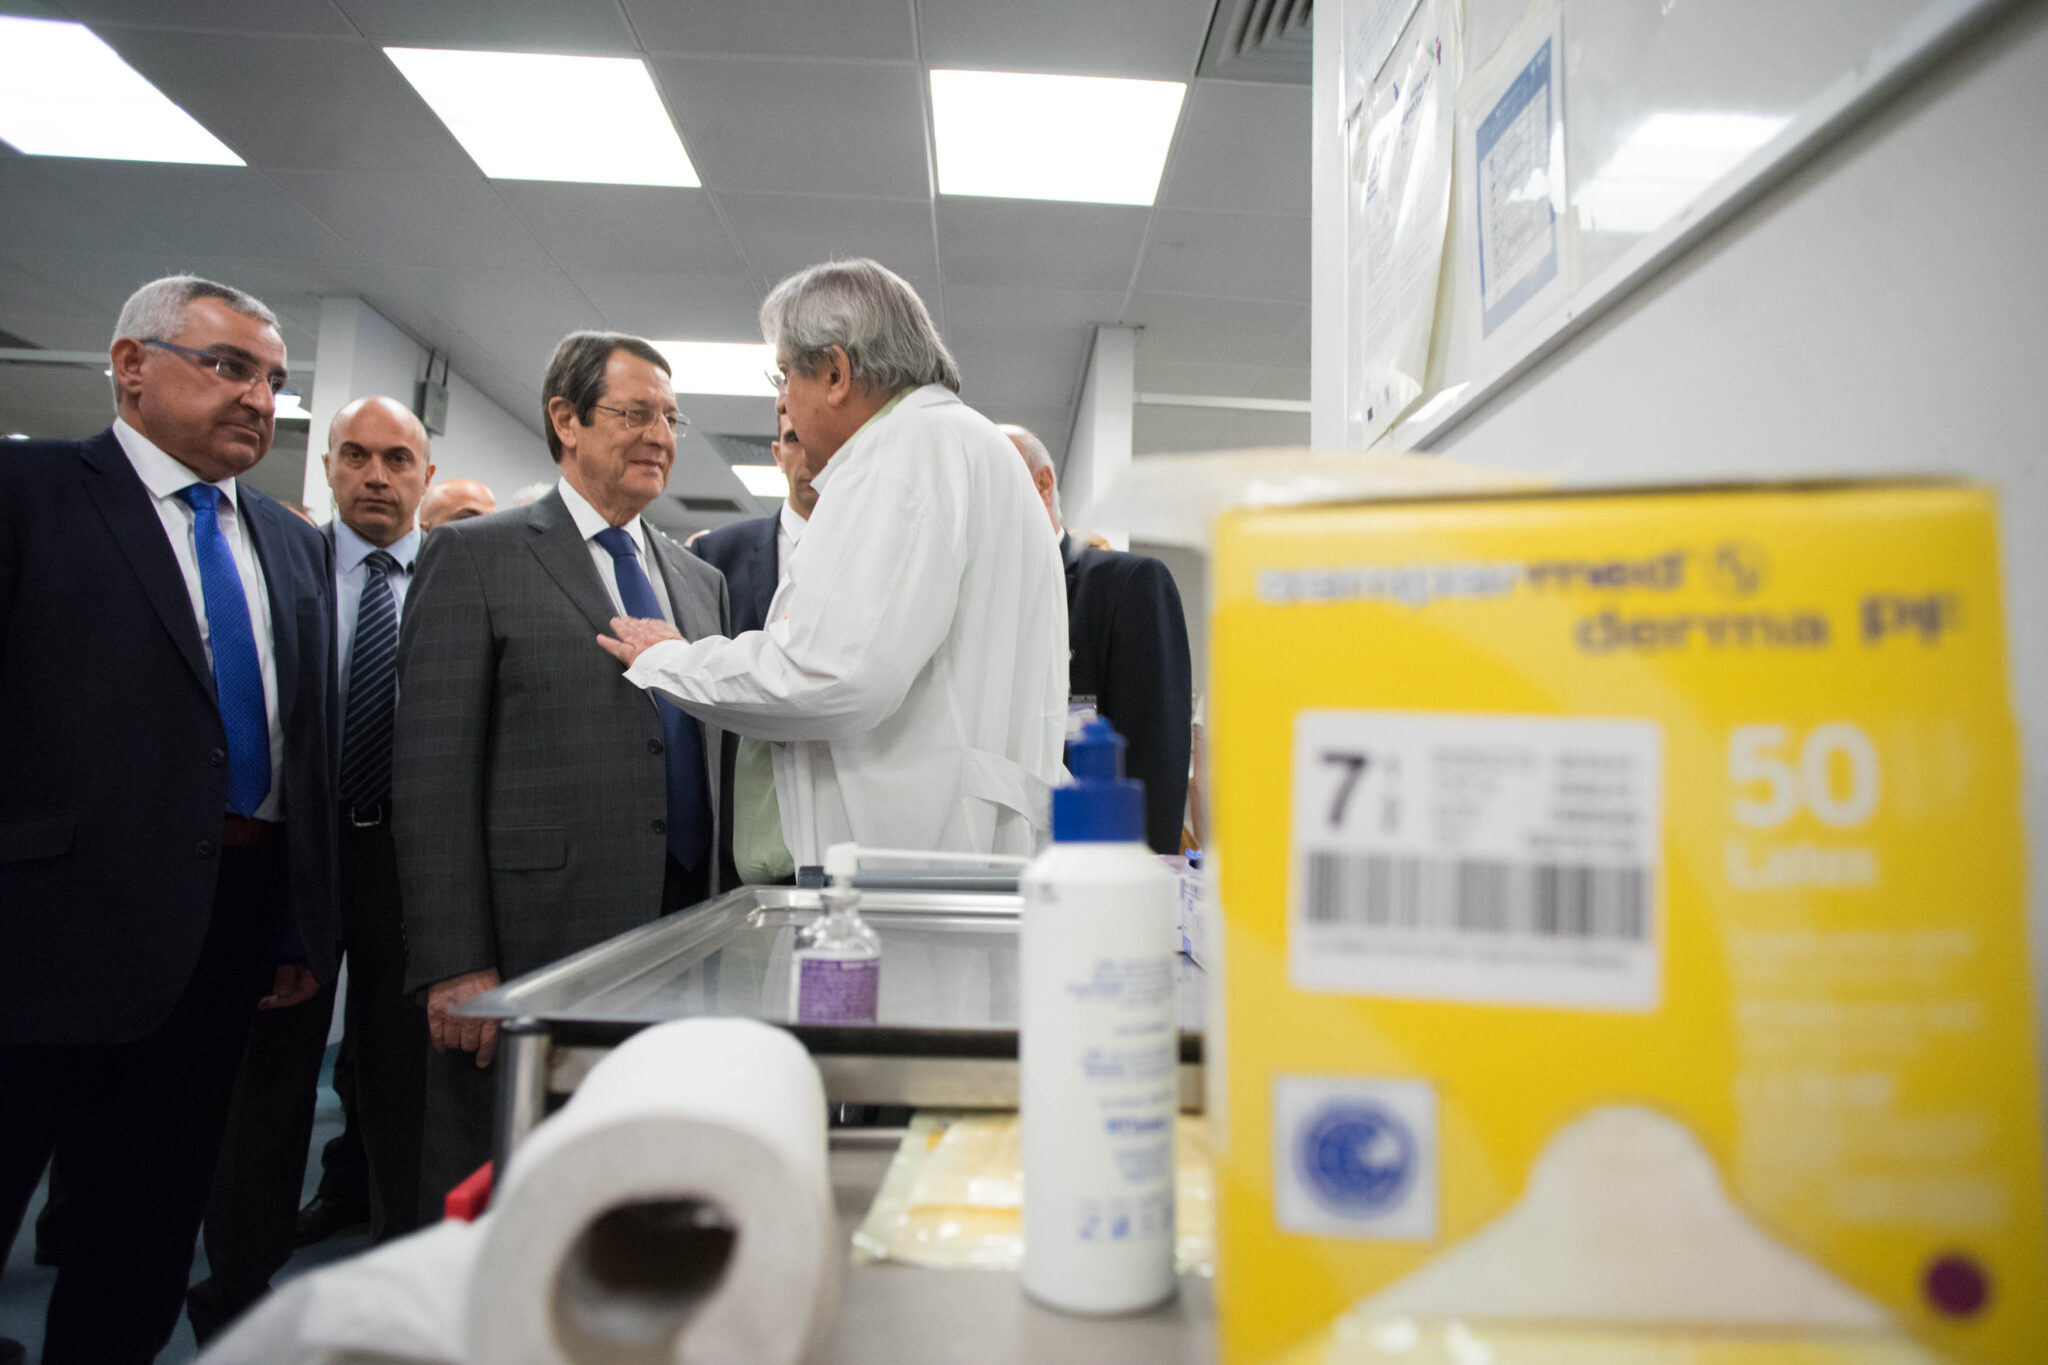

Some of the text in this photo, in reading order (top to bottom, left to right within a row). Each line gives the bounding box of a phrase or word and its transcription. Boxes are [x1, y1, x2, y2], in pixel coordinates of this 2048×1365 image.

[1574, 606, 1831, 653] derma
[1318, 750, 1368, 828] 7
[1728, 723, 1879, 828] 50
